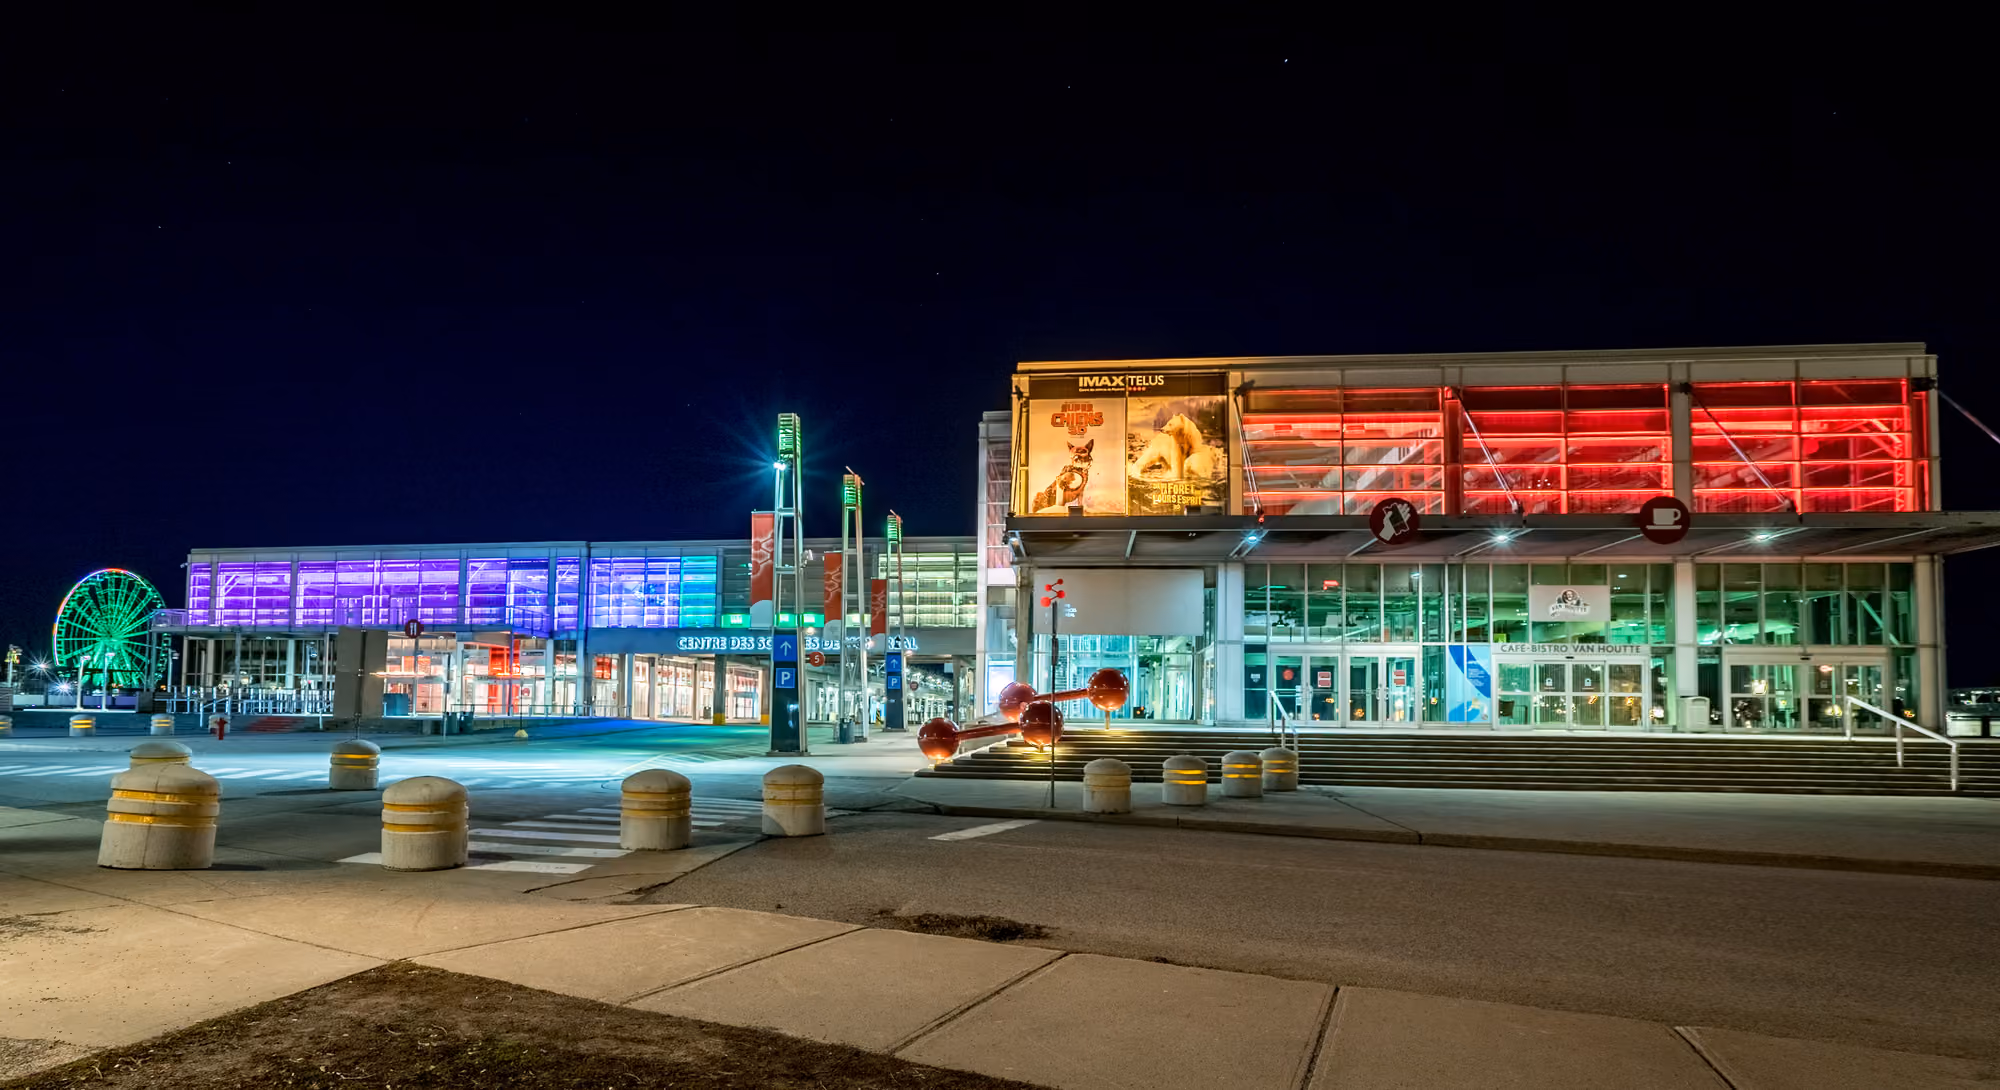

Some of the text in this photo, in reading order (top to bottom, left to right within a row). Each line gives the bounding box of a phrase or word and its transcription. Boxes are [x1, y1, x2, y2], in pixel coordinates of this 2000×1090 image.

[1079, 375, 1164, 387] IMAX TELUS
[677, 636, 727, 650] CENTRE
[729, 636, 755, 650] DES
[1573, 644, 1595, 653] VAN
[1598, 644, 1641, 653] HOUTTE
[781, 671, 791, 685] P
[891, 678, 898, 687] P
